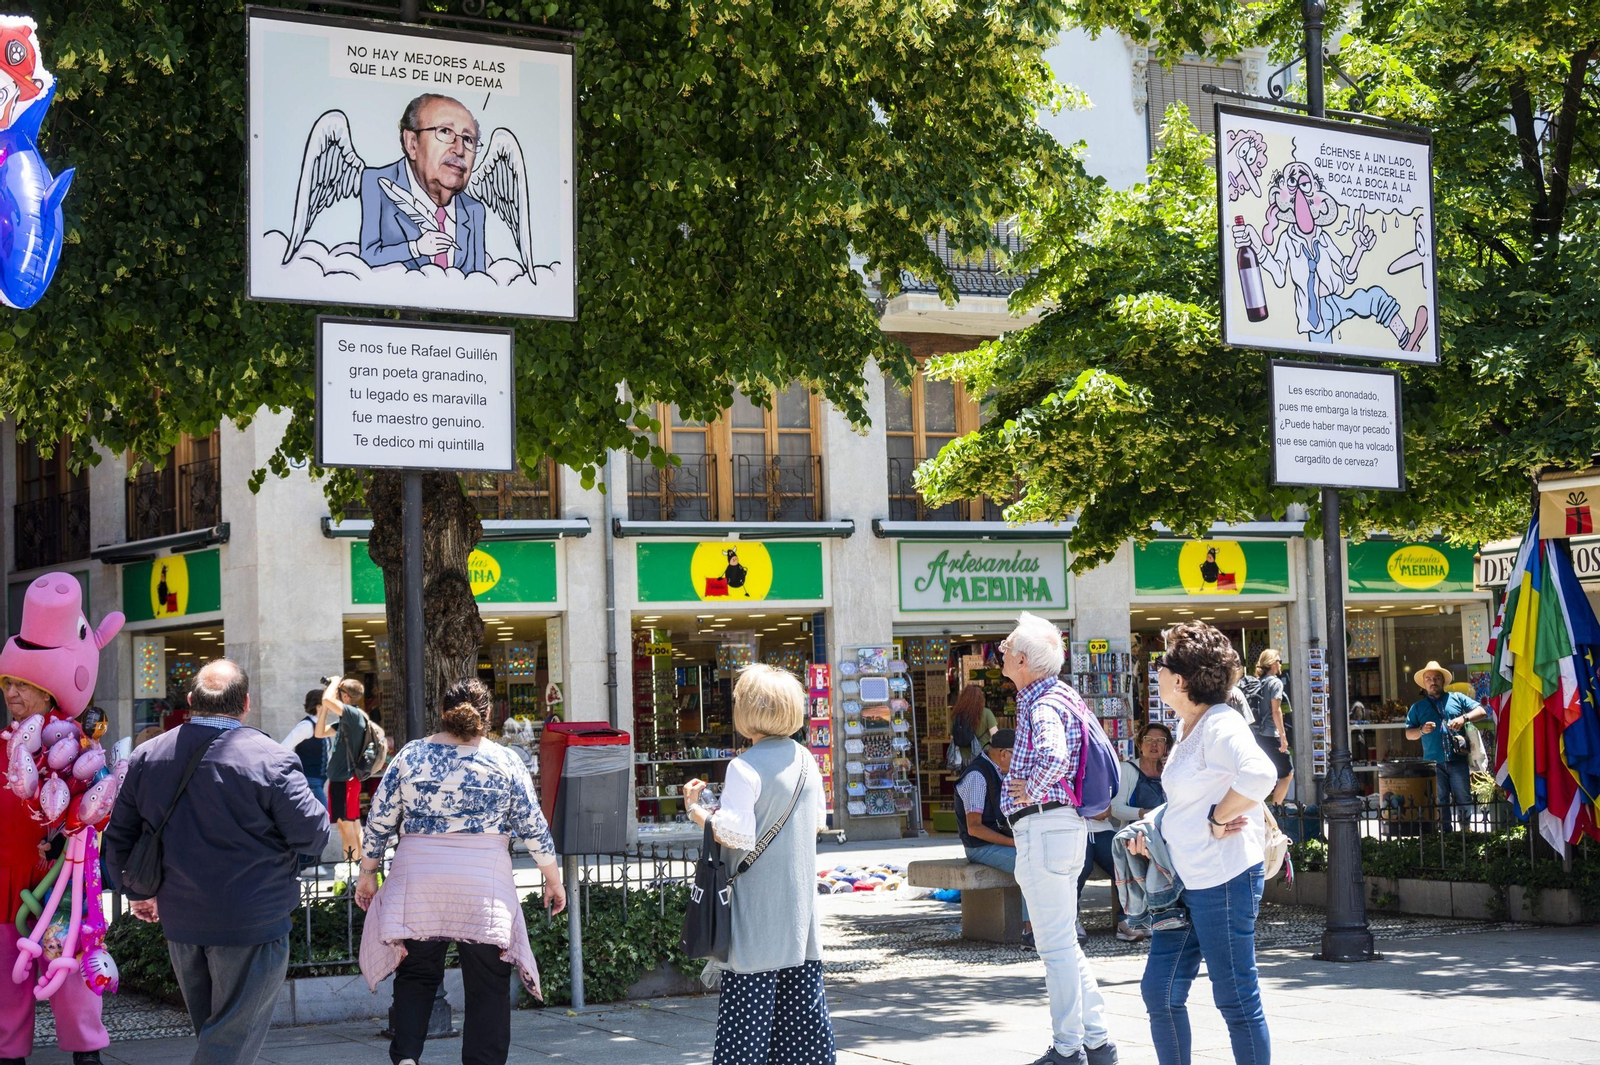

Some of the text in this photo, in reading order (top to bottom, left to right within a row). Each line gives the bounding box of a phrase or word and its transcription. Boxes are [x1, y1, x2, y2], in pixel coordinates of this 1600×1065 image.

[348, 45, 506, 74] NO HAY MEJORES ALAS
[350, 62, 503, 90] QUE LAS DE UN POEMA
[1320, 143, 1415, 169] ÉCHENSE A UN LADO,
[1315, 157, 1418, 182] QUE VOY A HACERLE EL
[1328, 172, 1412, 194] BOCA A BOCA A LA
[1341, 187, 1404, 204] ACCIDENTADA
[338, 340, 498, 362] Se nos fue Rafael Guillén
[349, 367, 487, 385] gran poeta granadino,
[350, 388, 487, 406] tu legado es maravilla
[1289, 385, 1380, 402] Les escribo anonadado,
[352, 410, 485, 430] fue maestro genuino.
[1279, 404, 1389, 419] pues me embarga la tristeza.
[1280, 419, 1390, 435] ¿Puede haber mayor pecado
[353, 434, 485, 453] Te dedico mi quintilla
[1277, 438, 1395, 452] que ese camión que ha volcado
[1295, 455, 1379, 468] cargadito de cerveza?
[914, 549, 1040, 592] Artesanías
[1400, 564, 1445, 576] MEDINA
[943, 576, 1053, 602] MEDINA
